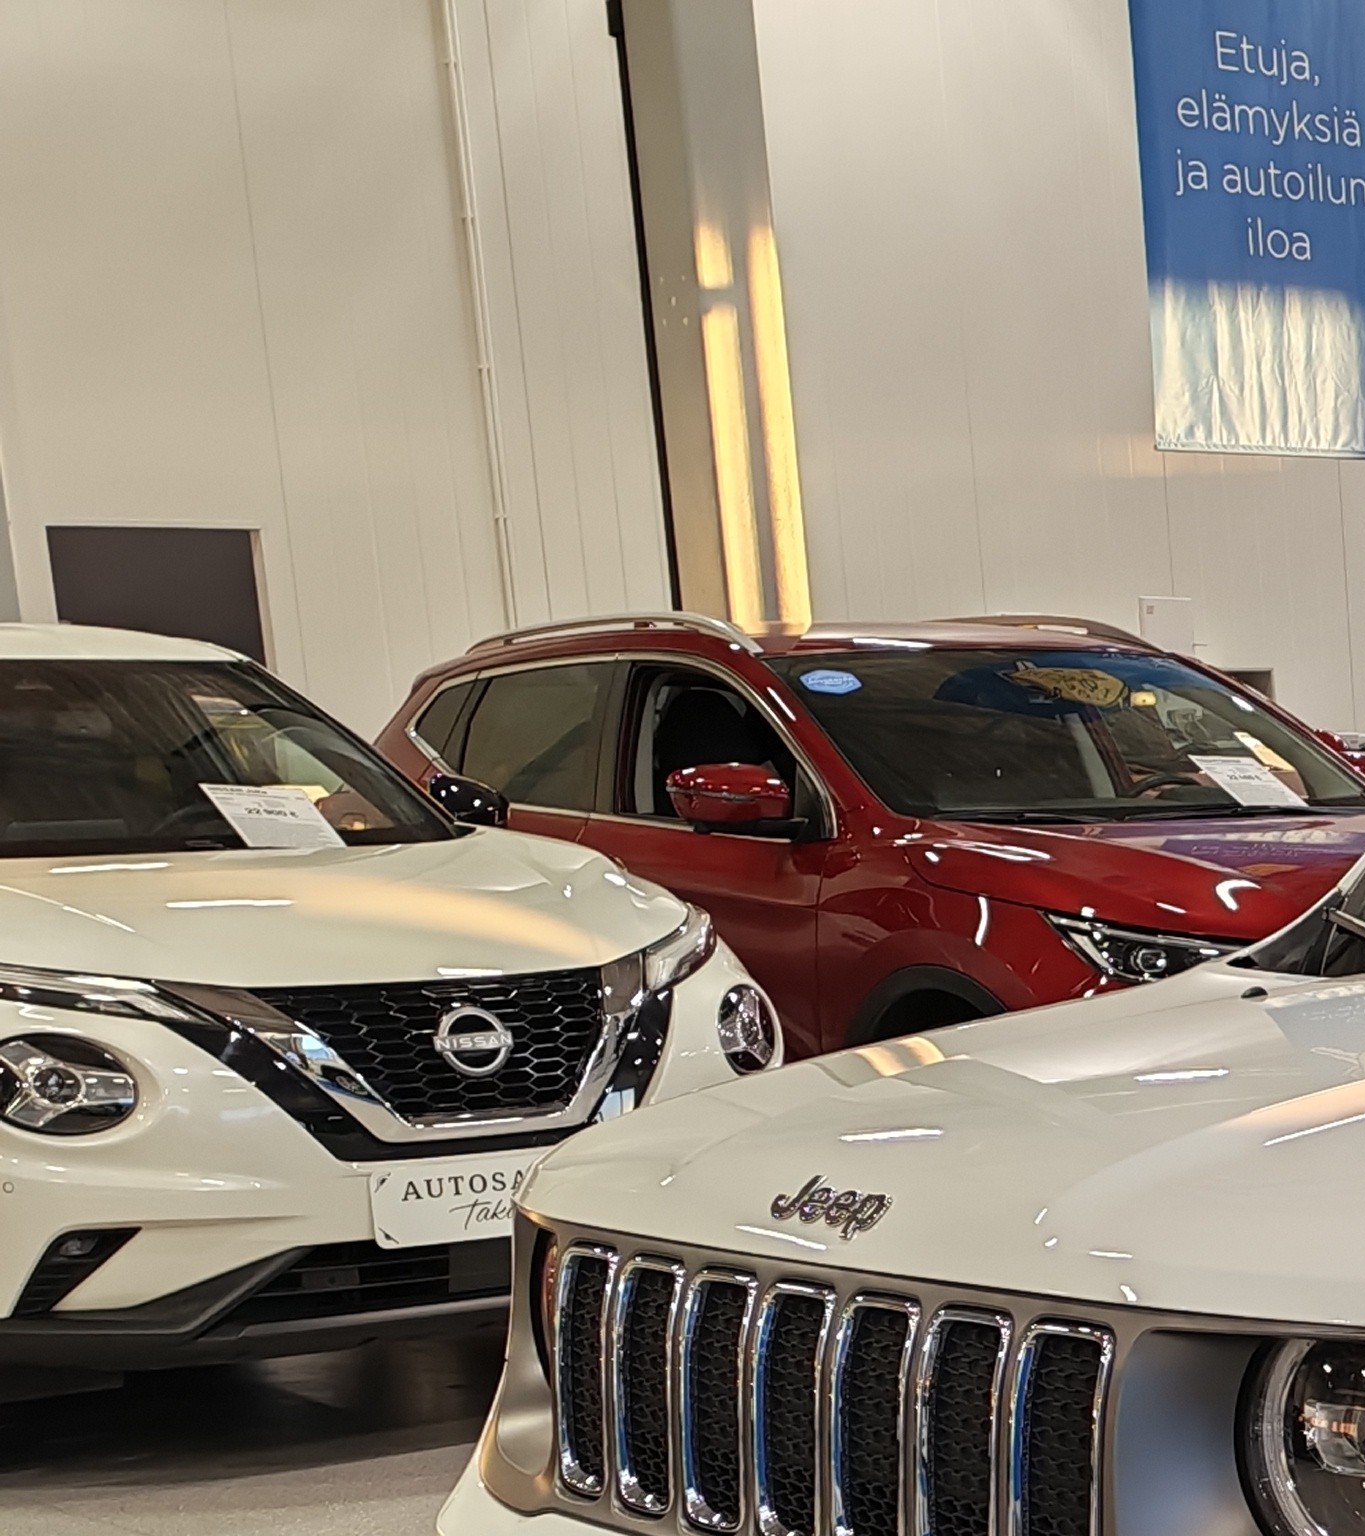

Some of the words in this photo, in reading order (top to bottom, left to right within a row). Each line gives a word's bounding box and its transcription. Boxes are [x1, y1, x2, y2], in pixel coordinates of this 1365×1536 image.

[1214, 31, 1320, 86] Etuja,
[1176, 89, 1362, 147] elämyksiä
[1176, 149, 1208, 195] ja
[1247, 217, 1311, 260] iloa
[436, 1033, 512, 1049] NISSAN
[770, 1175, 893, 1241] Jeep
